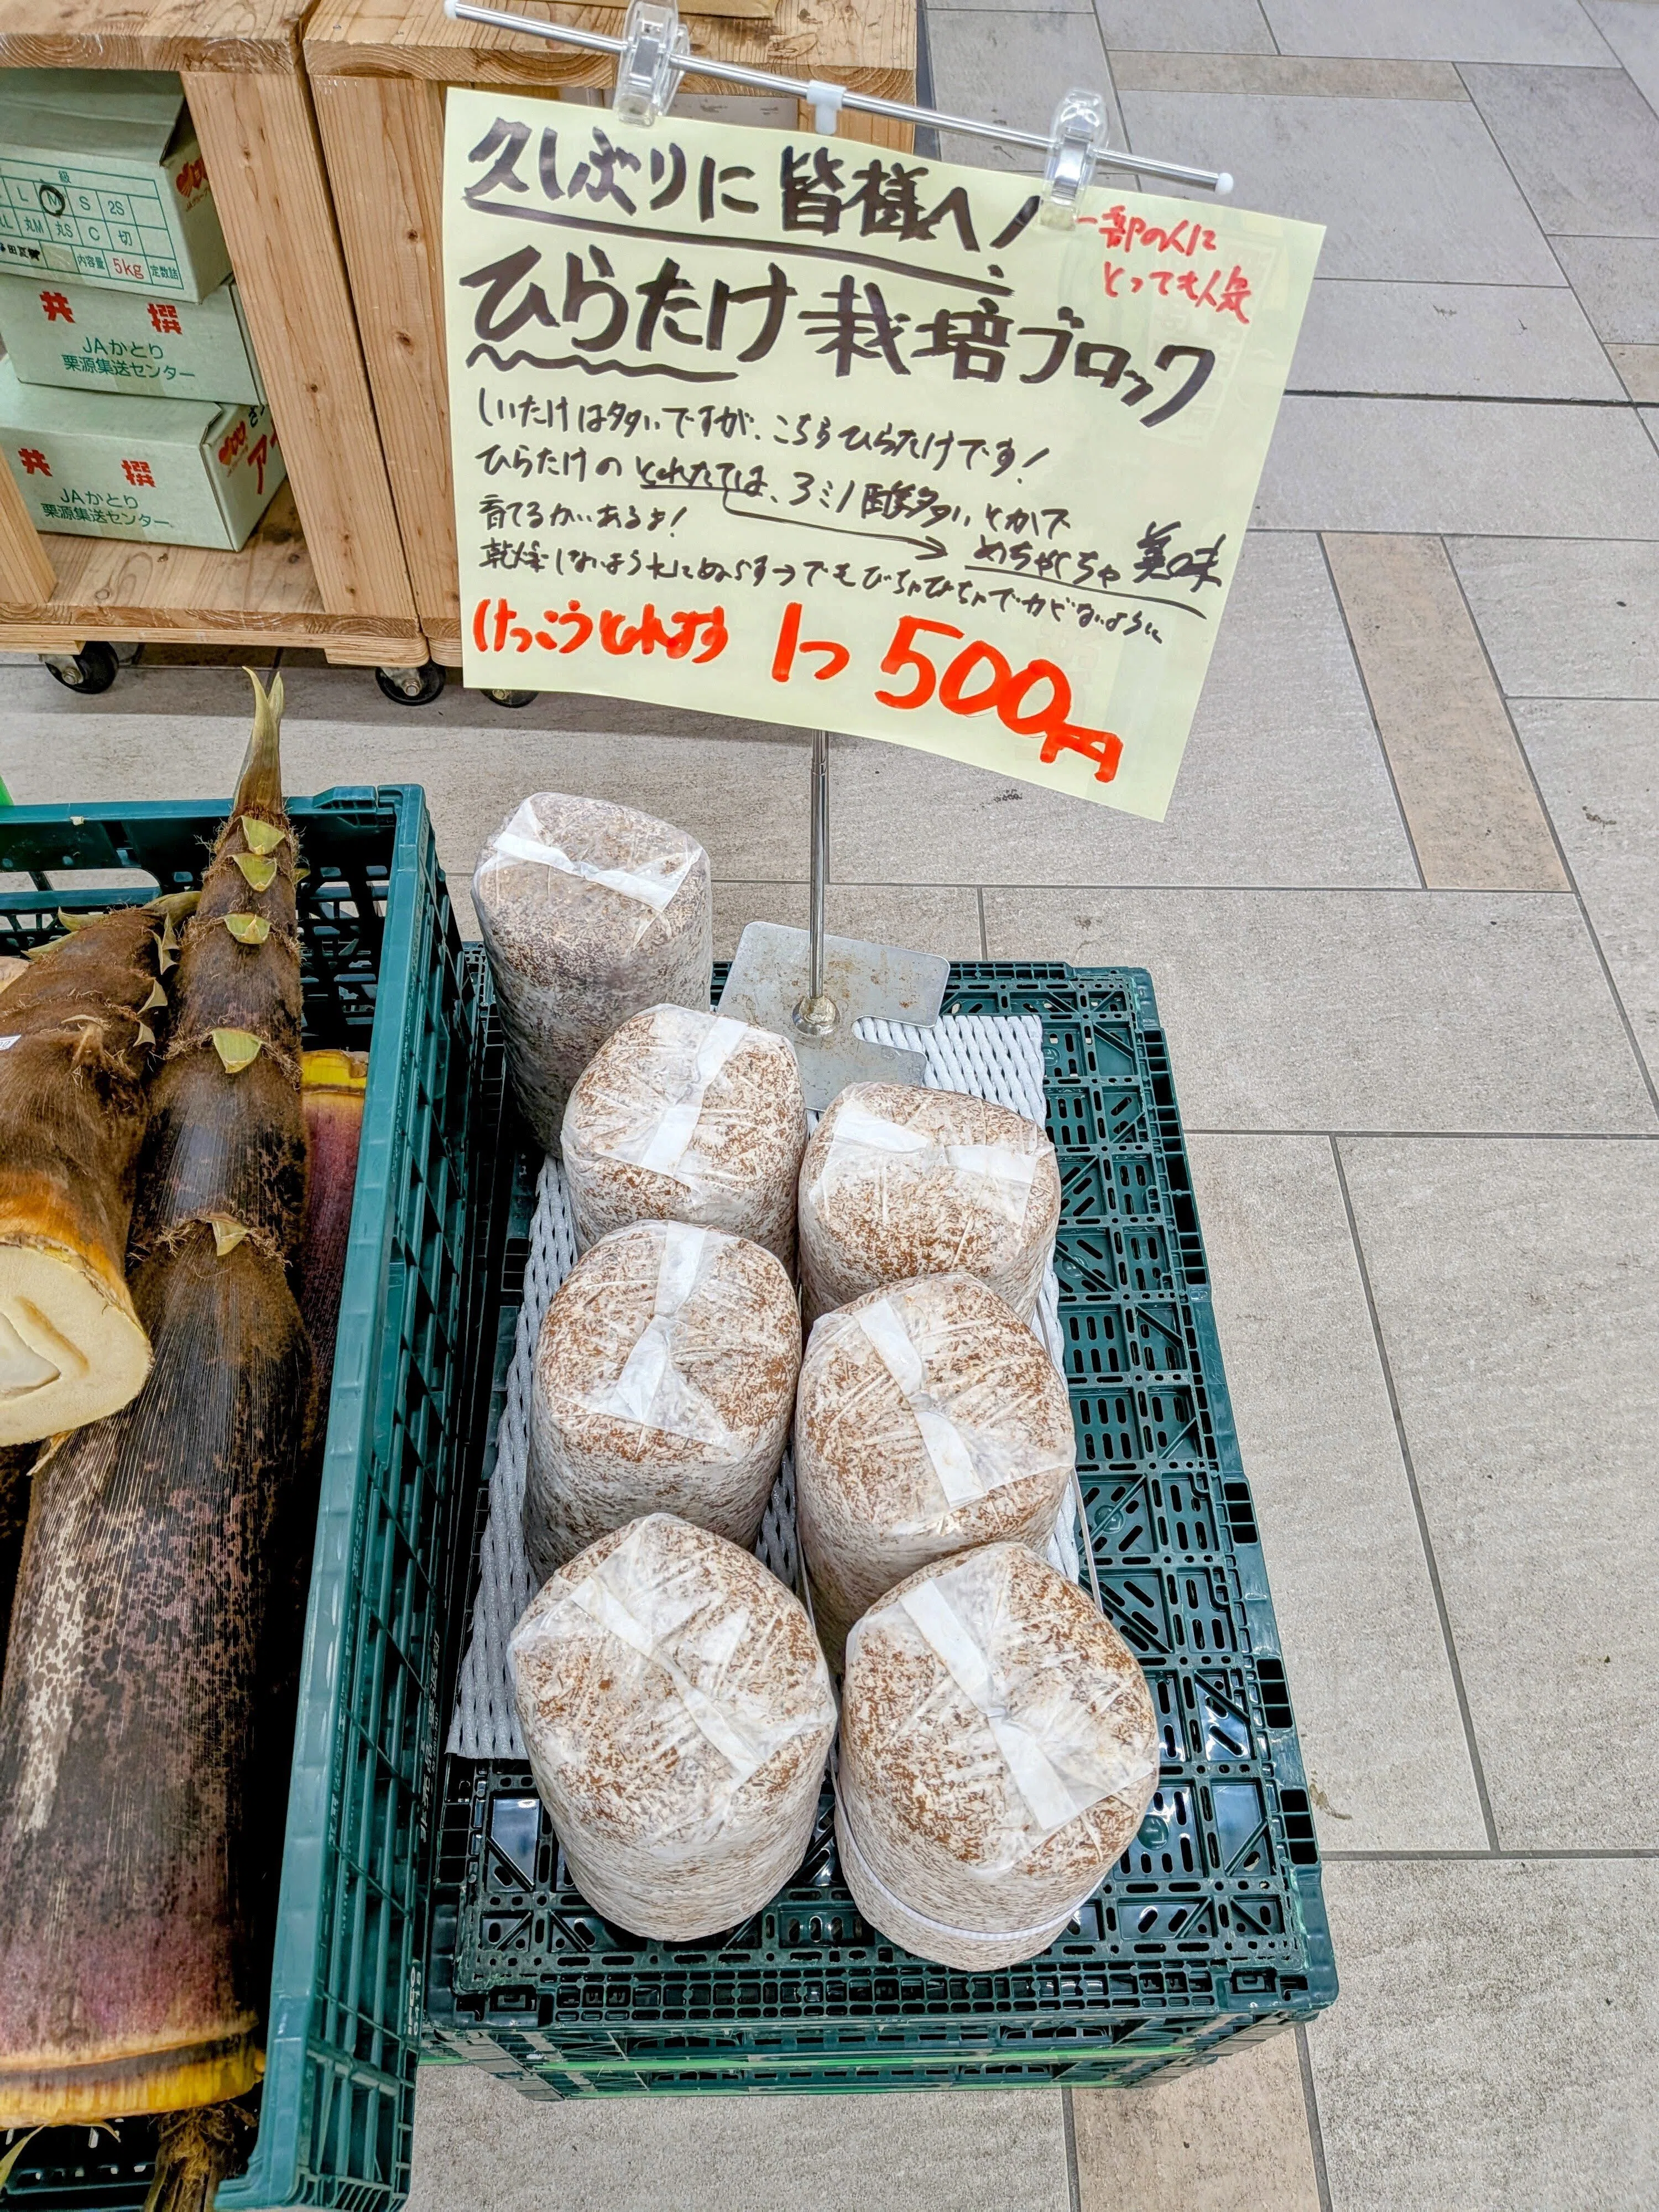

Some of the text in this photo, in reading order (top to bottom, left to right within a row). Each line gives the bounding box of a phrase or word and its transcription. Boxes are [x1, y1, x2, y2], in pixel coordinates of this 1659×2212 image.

[17, 186, 29, 202] L
[79, 196, 91, 211] S
[107, 200, 125, 216] 2S
[24, 216, 44, 233] 丸M
[55, 221, 73, 238] 丸S
[88, 226, 100, 241] C
[118, 230, 133, 247] 切
[77, 254, 179, 280] 内容量 5kg 定数詰
[82, 336, 164, 360] JAかとり
[460, 244, 1215, 428] ひらたけ栽培ブロック
[61, 354, 196, 380] 栗源集送センター
[59, 488, 139, 510] JAかとり
[40, 503, 169, 528] 栗源集送センター
[873, 615, 1124, 784] 500円
